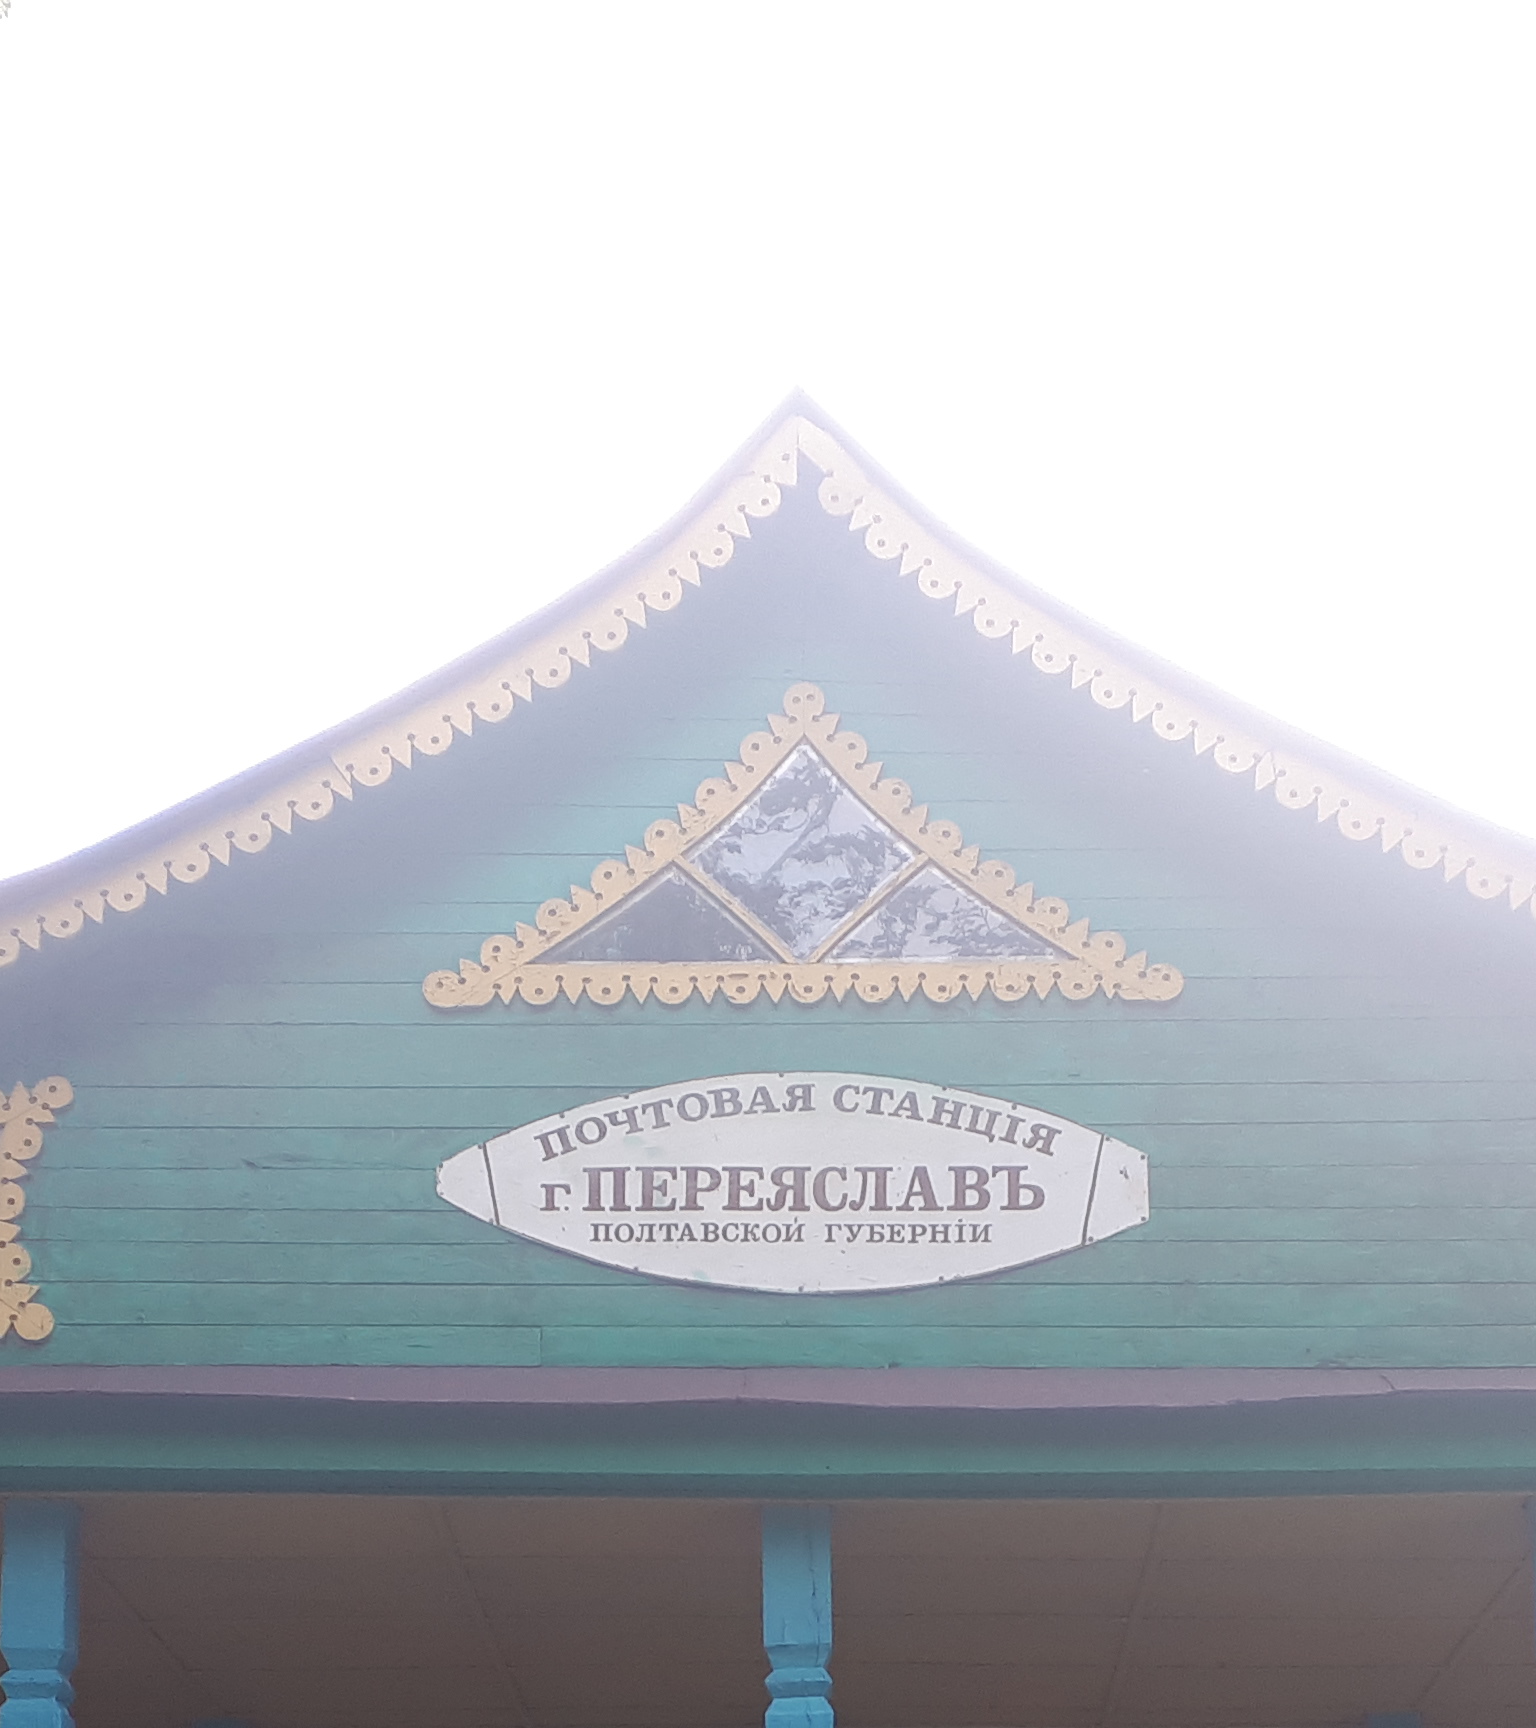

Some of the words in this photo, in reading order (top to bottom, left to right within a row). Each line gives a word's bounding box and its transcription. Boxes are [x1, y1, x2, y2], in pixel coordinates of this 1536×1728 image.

[533, 1083, 817, 1162] ПОЧТОВАЯ
[832, 1083, 1063, 1157] СТАНЦІЯ
[581, 1165, 1047, 1212] ПЕРЕЯСЛАВЪ
[589, 1216, 807, 1244] ПОЛТАВСКОЙ
